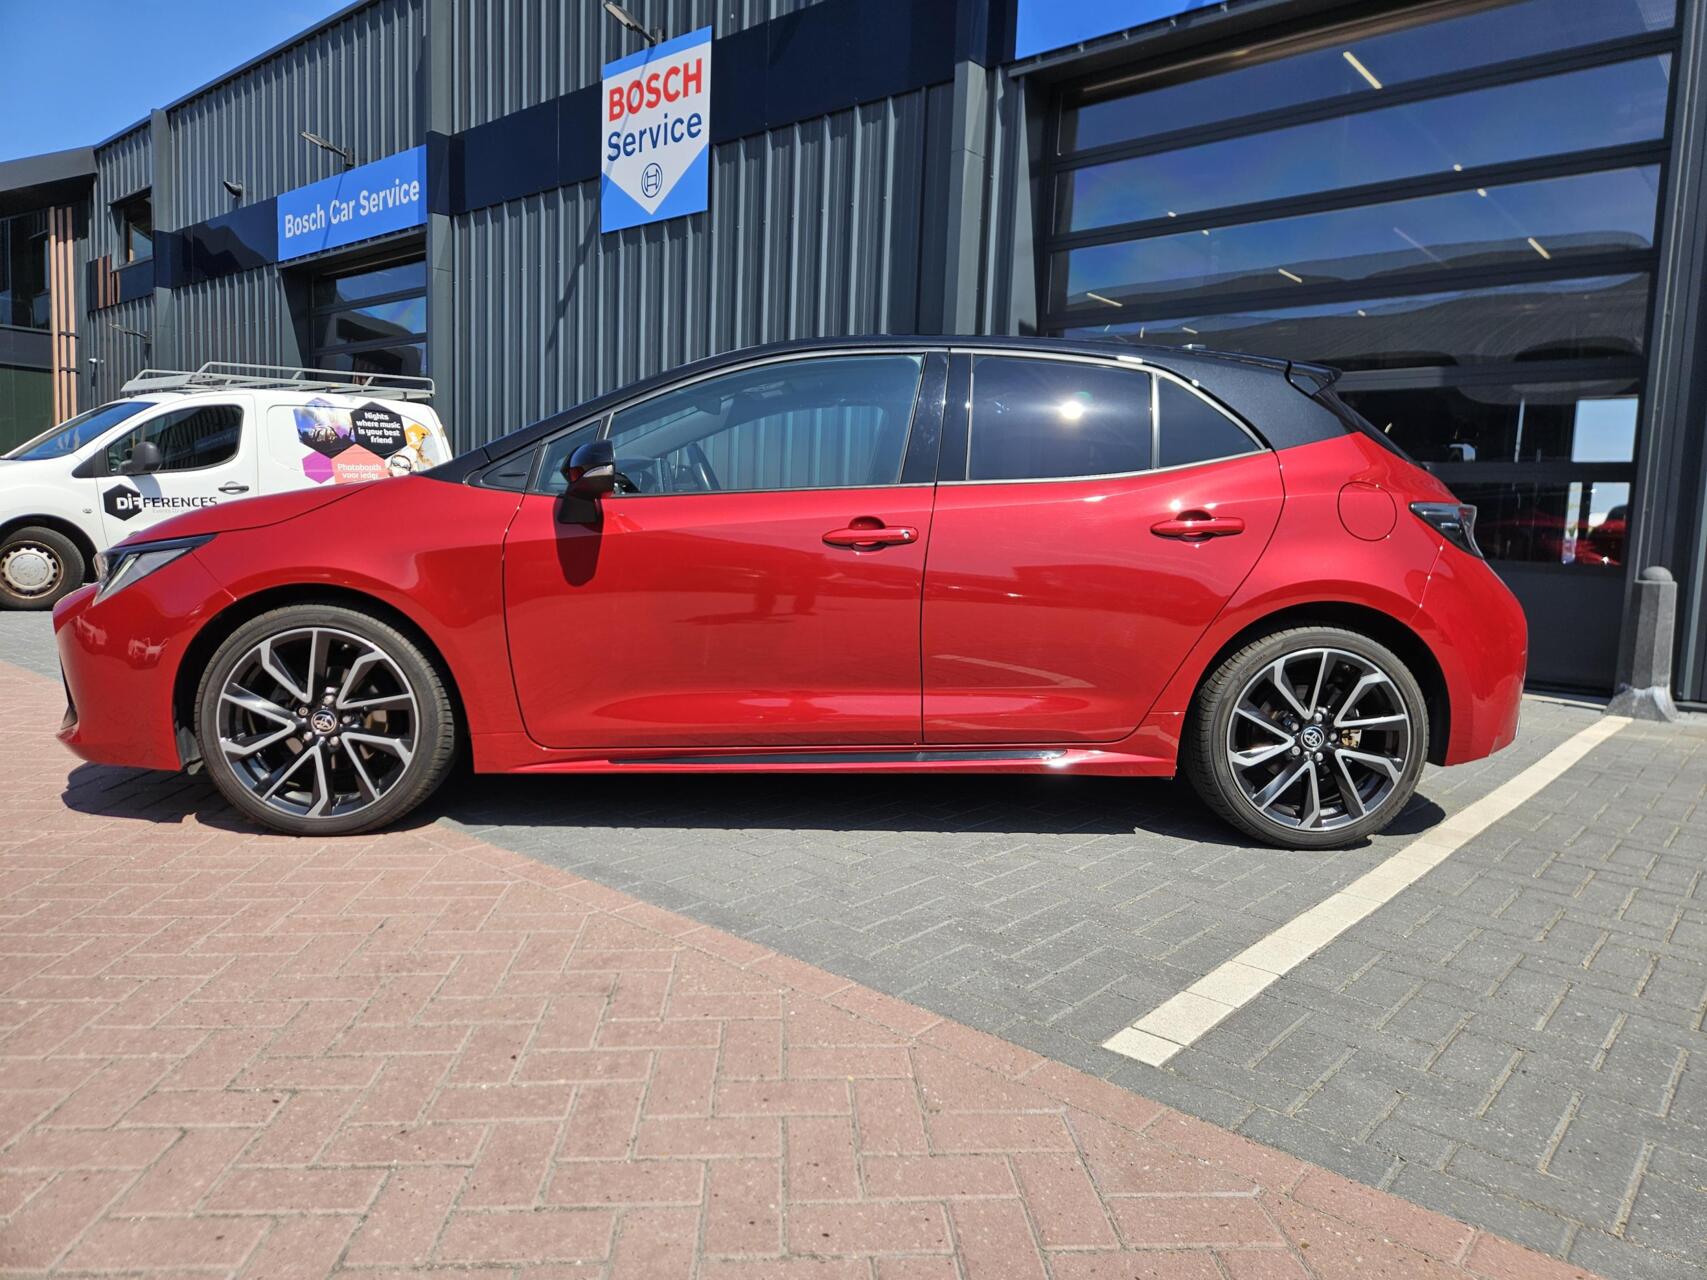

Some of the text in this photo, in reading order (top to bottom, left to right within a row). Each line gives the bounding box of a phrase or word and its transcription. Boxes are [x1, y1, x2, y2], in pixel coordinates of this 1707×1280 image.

[608, 58, 703, 122] BOSCH
[607, 112, 703, 162] Service
[284, 178, 420, 239] Bosch Car Service
[364, 412, 389, 420] Nights
[356, 419, 379, 428] where
[370, 435, 393, 444] friend
[337, 463, 382, 471] Photobooth
